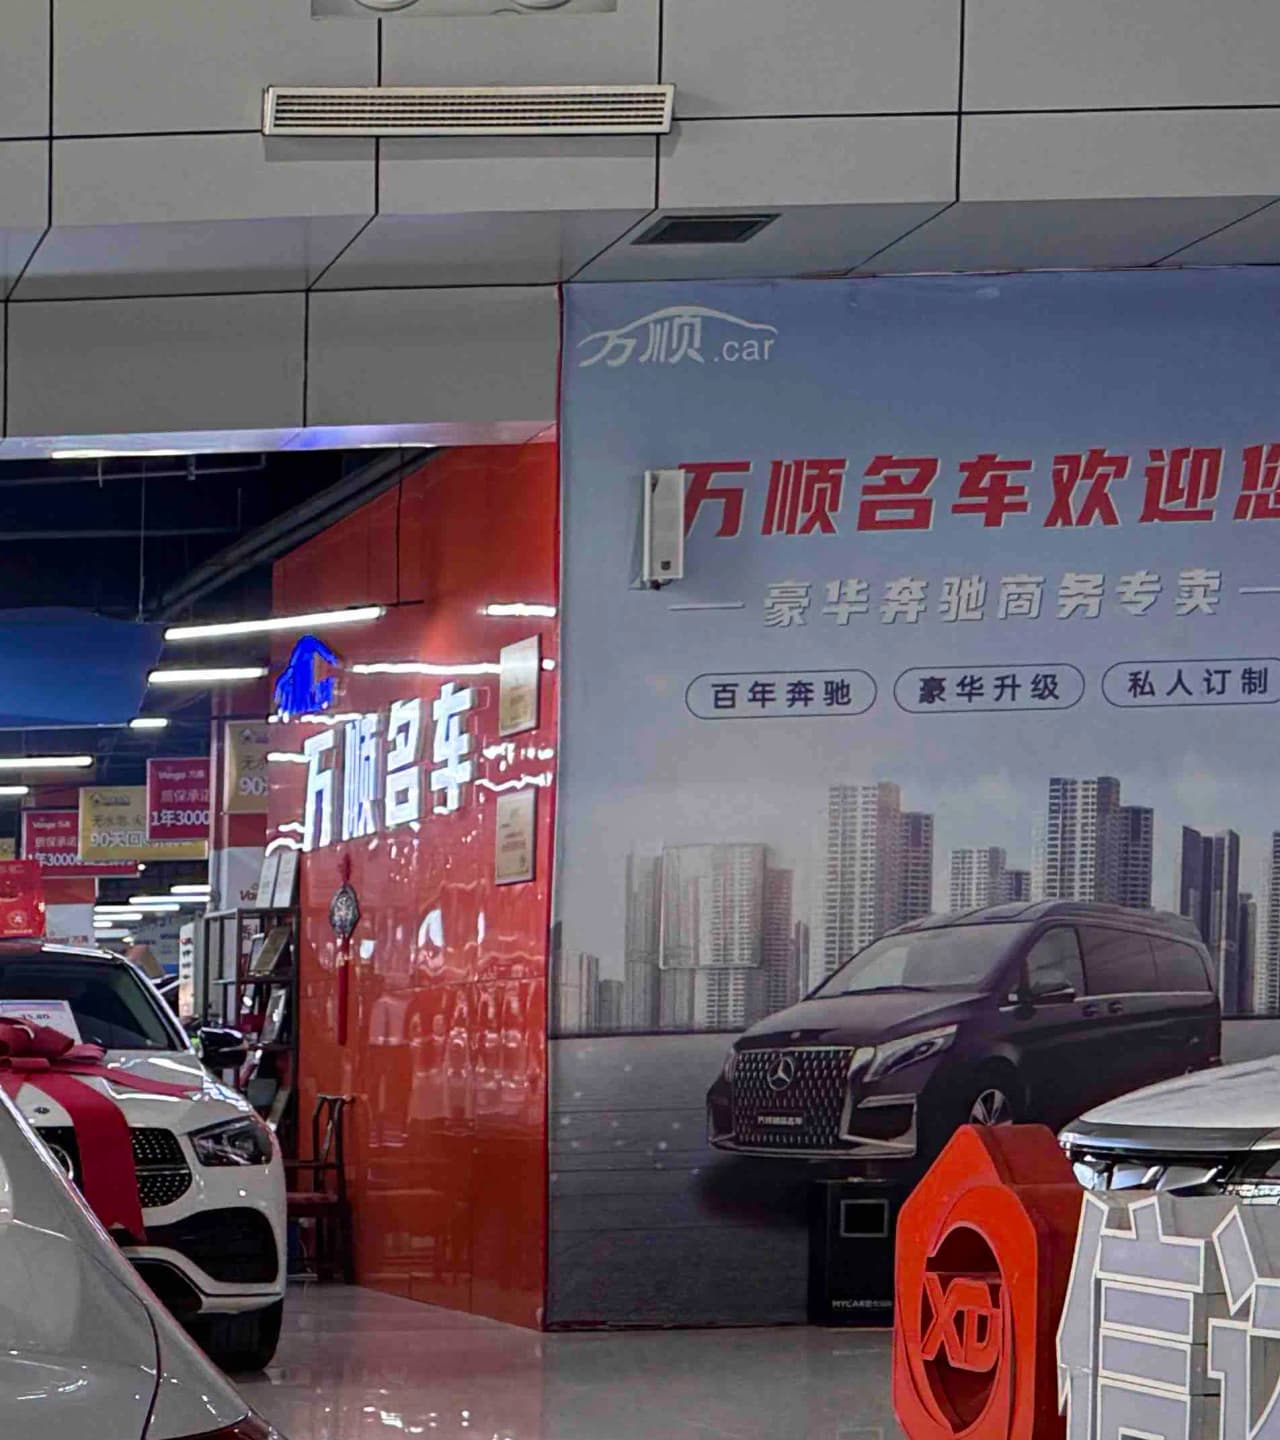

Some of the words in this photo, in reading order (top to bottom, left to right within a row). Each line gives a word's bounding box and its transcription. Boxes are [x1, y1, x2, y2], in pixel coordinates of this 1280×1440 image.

[763, 567, 1223, 627] 豪华奔驰商务专卖
[711, 679, 853, 711] 百年奔驰
[917, 673, 1060, 704] 豪华升级
[1126, 666, 1269, 700] 私人订制
[302, 681, 480, 854] 万顺名车
